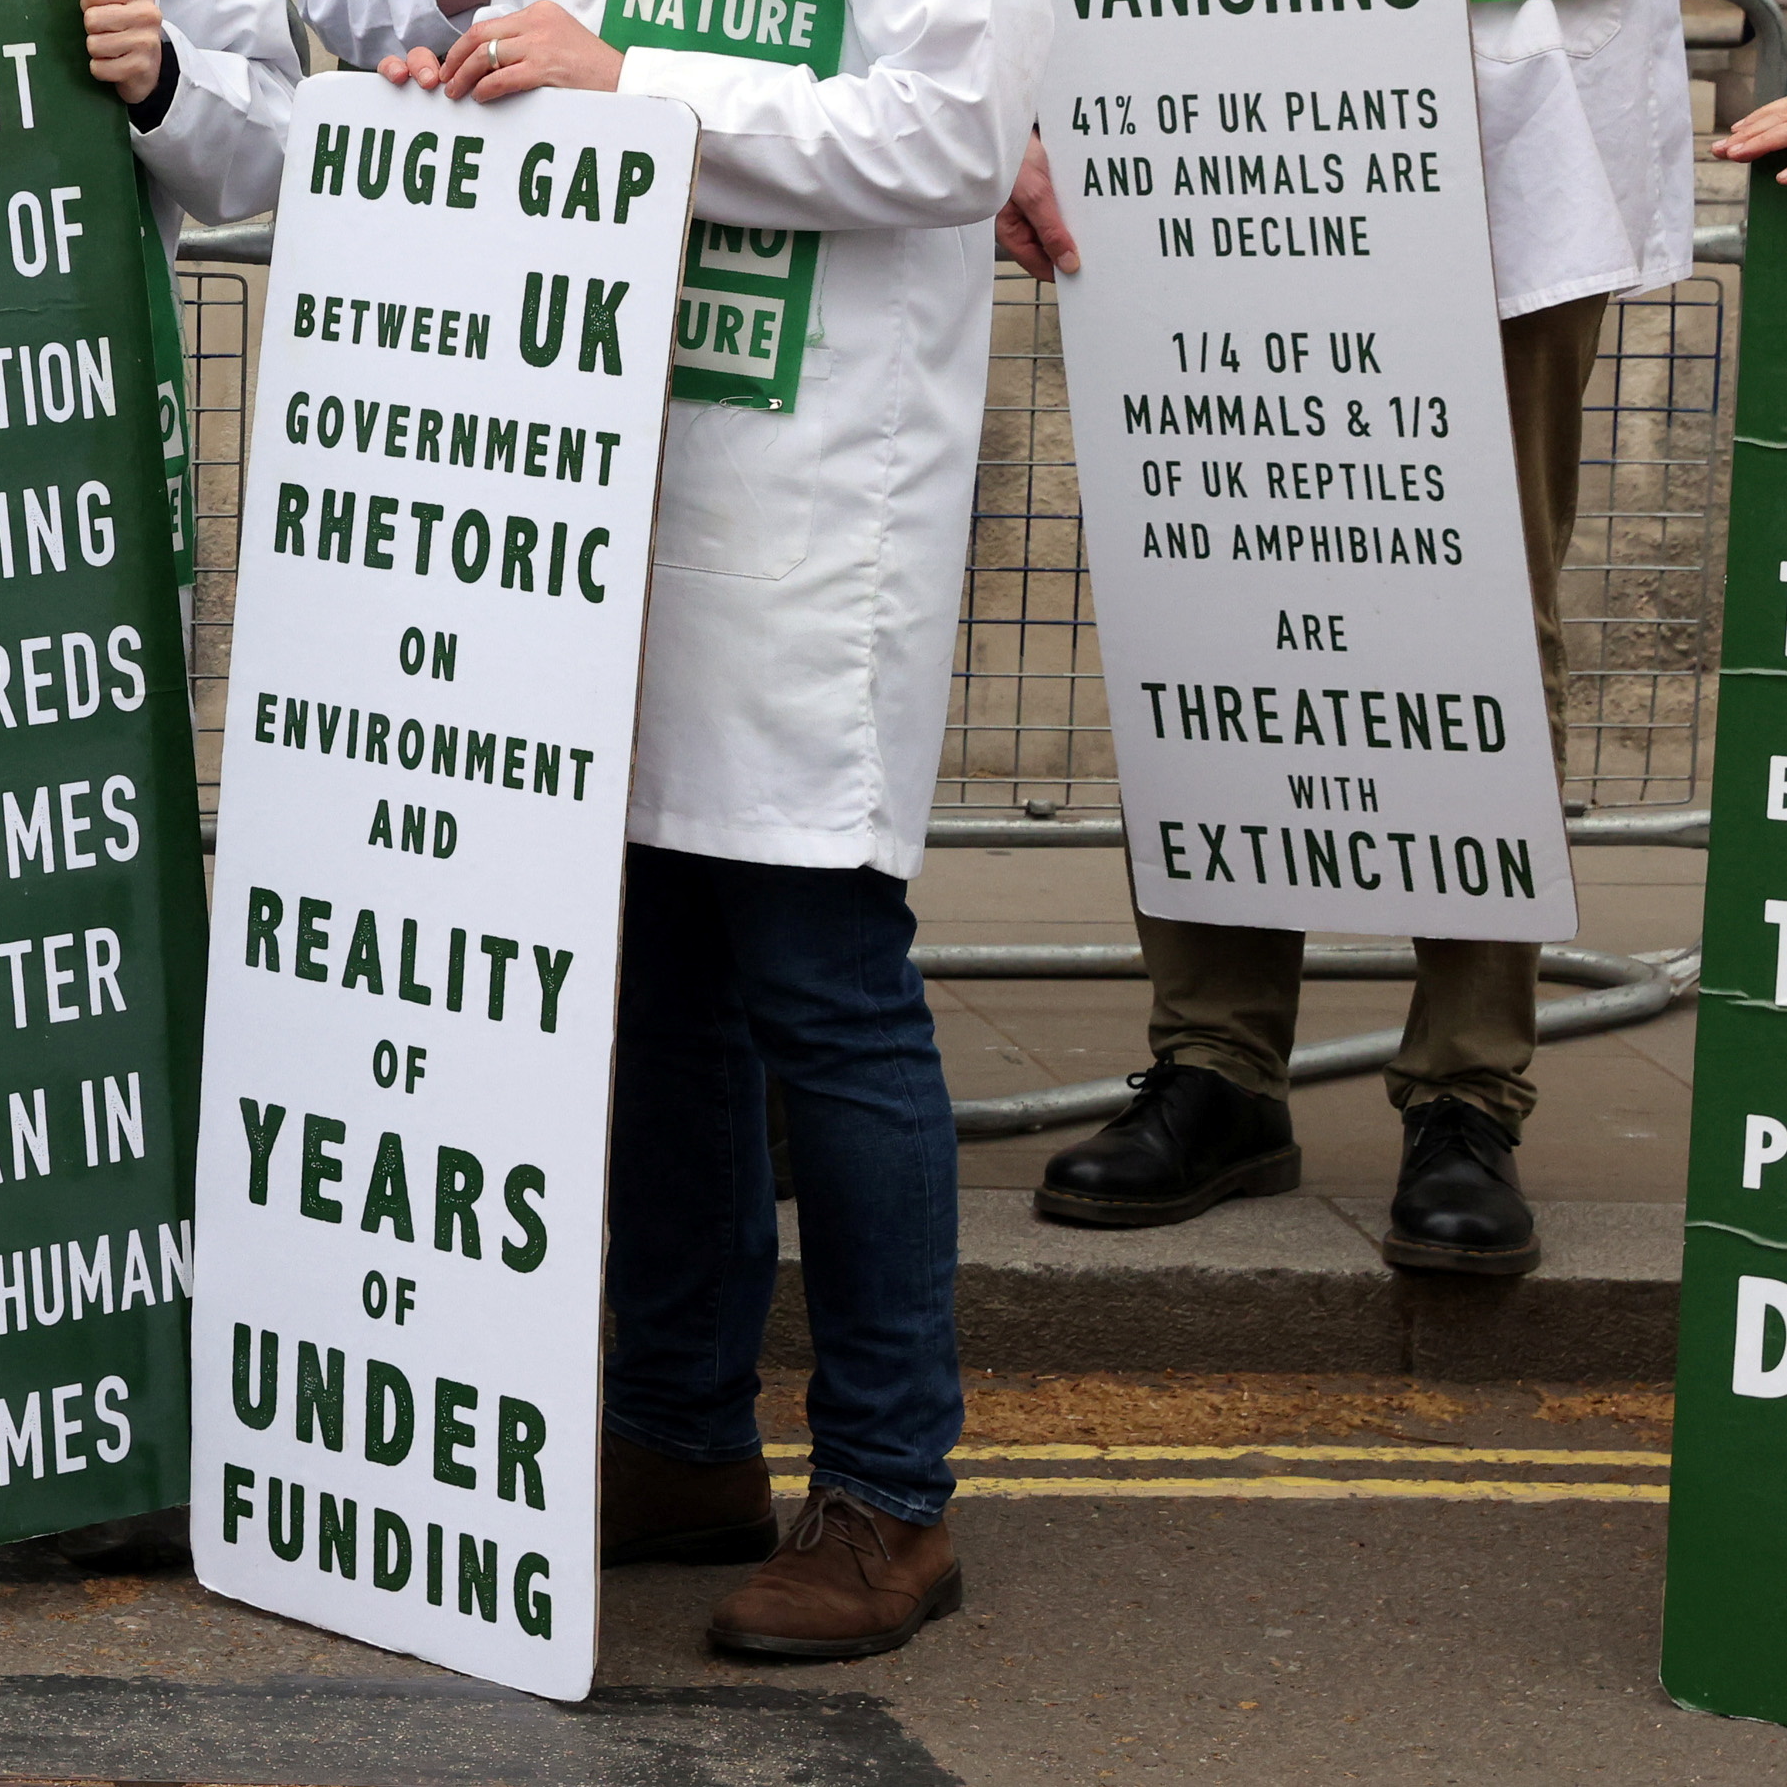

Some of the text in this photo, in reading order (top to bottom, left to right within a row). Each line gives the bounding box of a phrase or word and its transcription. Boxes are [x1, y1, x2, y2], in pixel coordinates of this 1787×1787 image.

[1072, 88, 1437, 135] 41% OF UK PLANTS
[310, 123, 654, 224] HUGE GAP
[1084, 152, 1440, 196] AND ANIMALS ARE
[8, 187, 82, 277] OF
[1159, 216, 1370, 257] IN DECLINE
[294, 272, 629, 376] BETWEEN UK
[1173, 332, 1381, 373] 1/4 OF UK
[286, 391, 620, 486] GOVERNMENT
[1124, 395, 1448, 438] MAMMALS & 1/3
[1143, 461, 1444, 501] OF UK REPTILES
[274, 483, 609, 603] RHETORIC
[1144, 523, 1462, 565] AND AMPHIBIANS
[400, 627, 457, 681] ON
[1277, 610, 1347, 651] ARE
[255, 692, 593, 801] ENVIRONMENT
[1141, 683, 1505, 752] THREATENED
[1288, 775, 1378, 812] WITH
[368, 799, 457, 859] AND
[1159, 821, 1535, 898] EXTINCTION
[246, 886, 573, 1033] REALITY
[373, 1039, 426, 1094] OF
[82, 1072, 144, 1166] IN
[239, 1097, 547, 1273] YEARS
[363, 1270, 416, 1326] OF
[232, 1322, 547, 1511] UNDER
[222, 1461, 554, 1641] FUNDING
